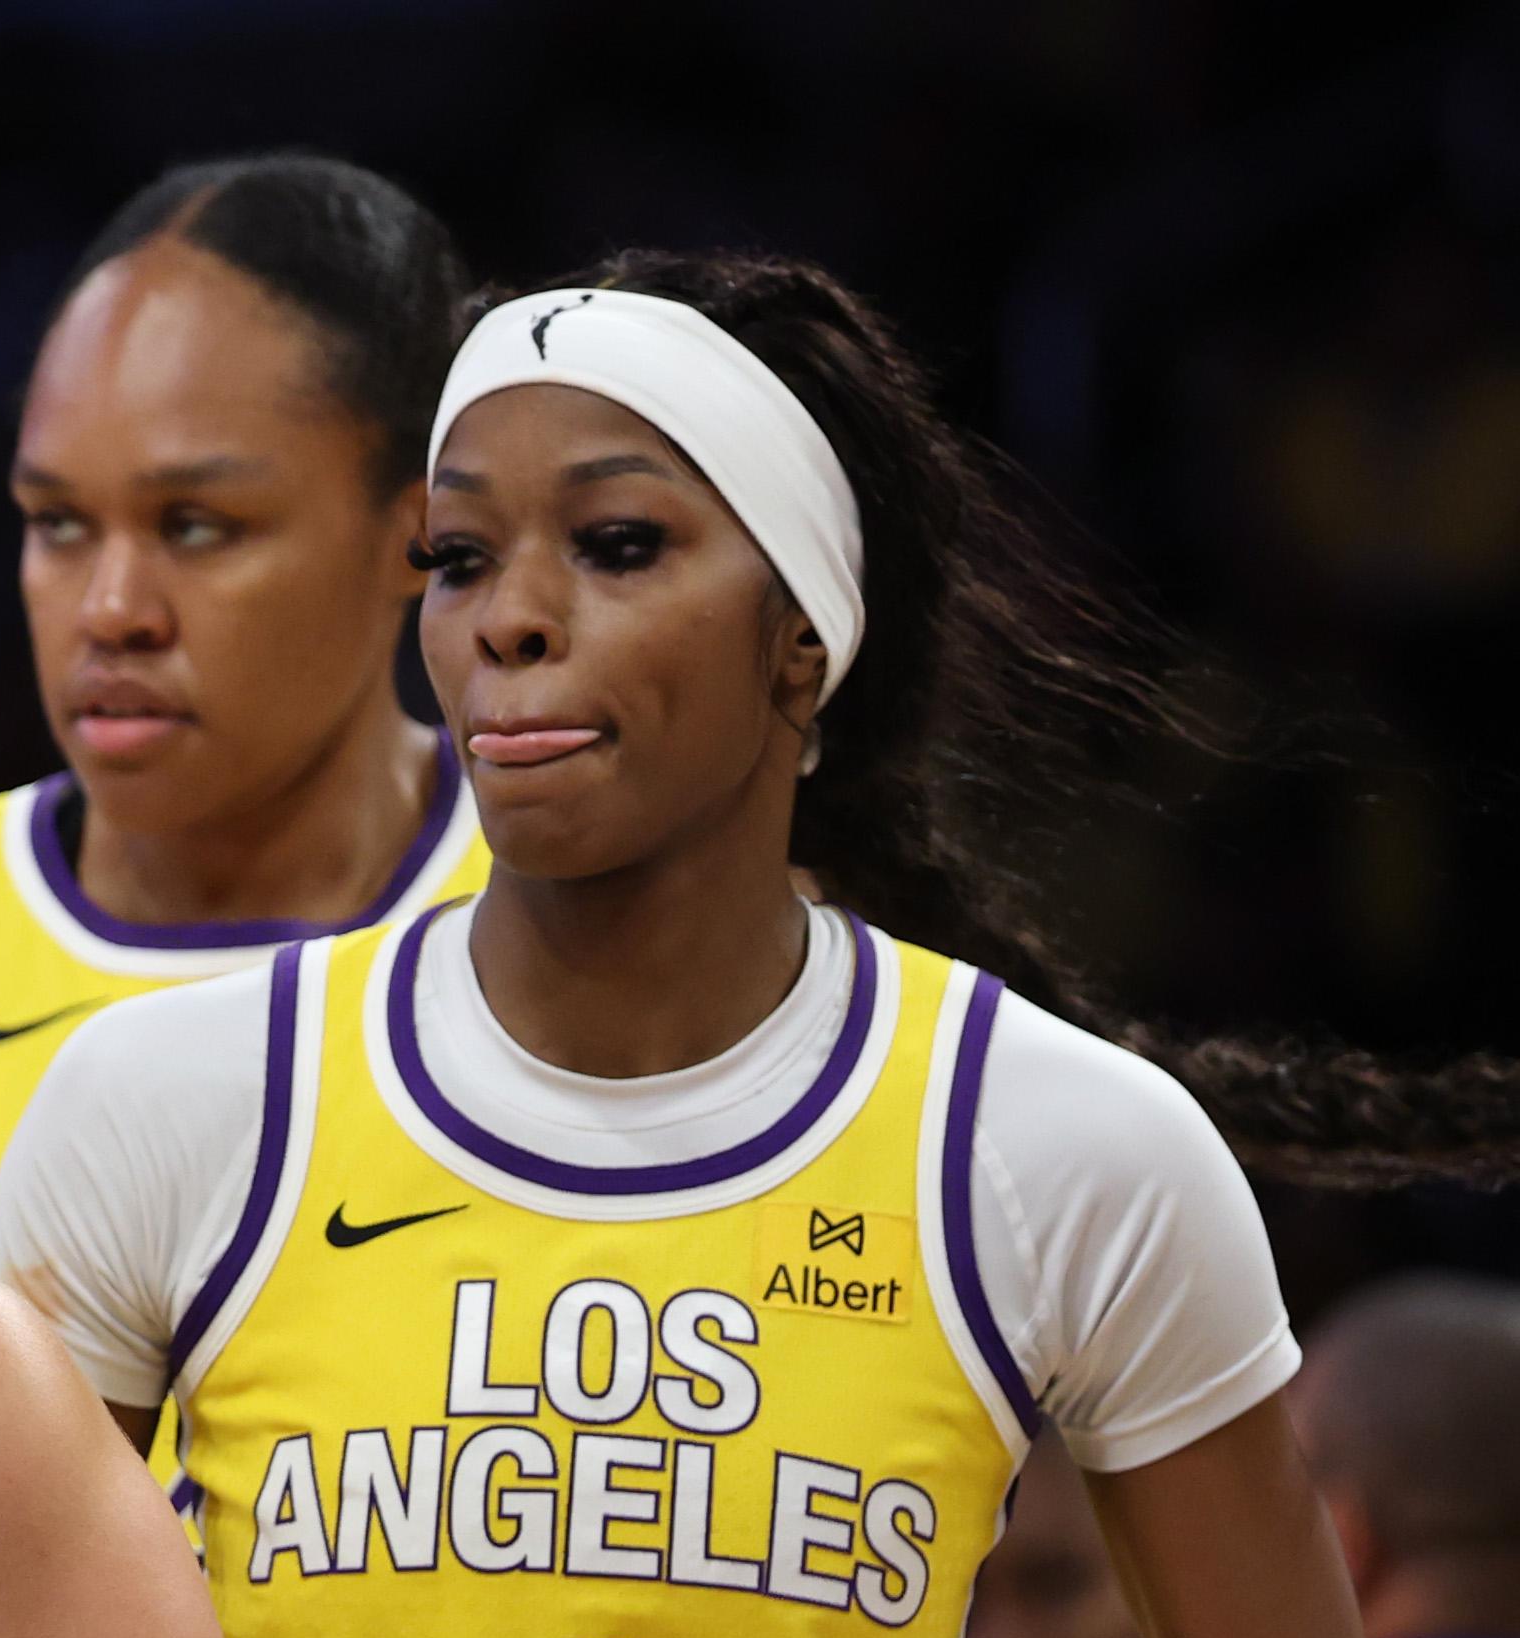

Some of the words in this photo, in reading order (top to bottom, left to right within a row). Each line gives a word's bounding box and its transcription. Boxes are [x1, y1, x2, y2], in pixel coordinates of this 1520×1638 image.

[445, 1277, 760, 1434] LOS
[762, 1263, 902, 1315] Albert
[247, 1424, 937, 1628] ANGELES
